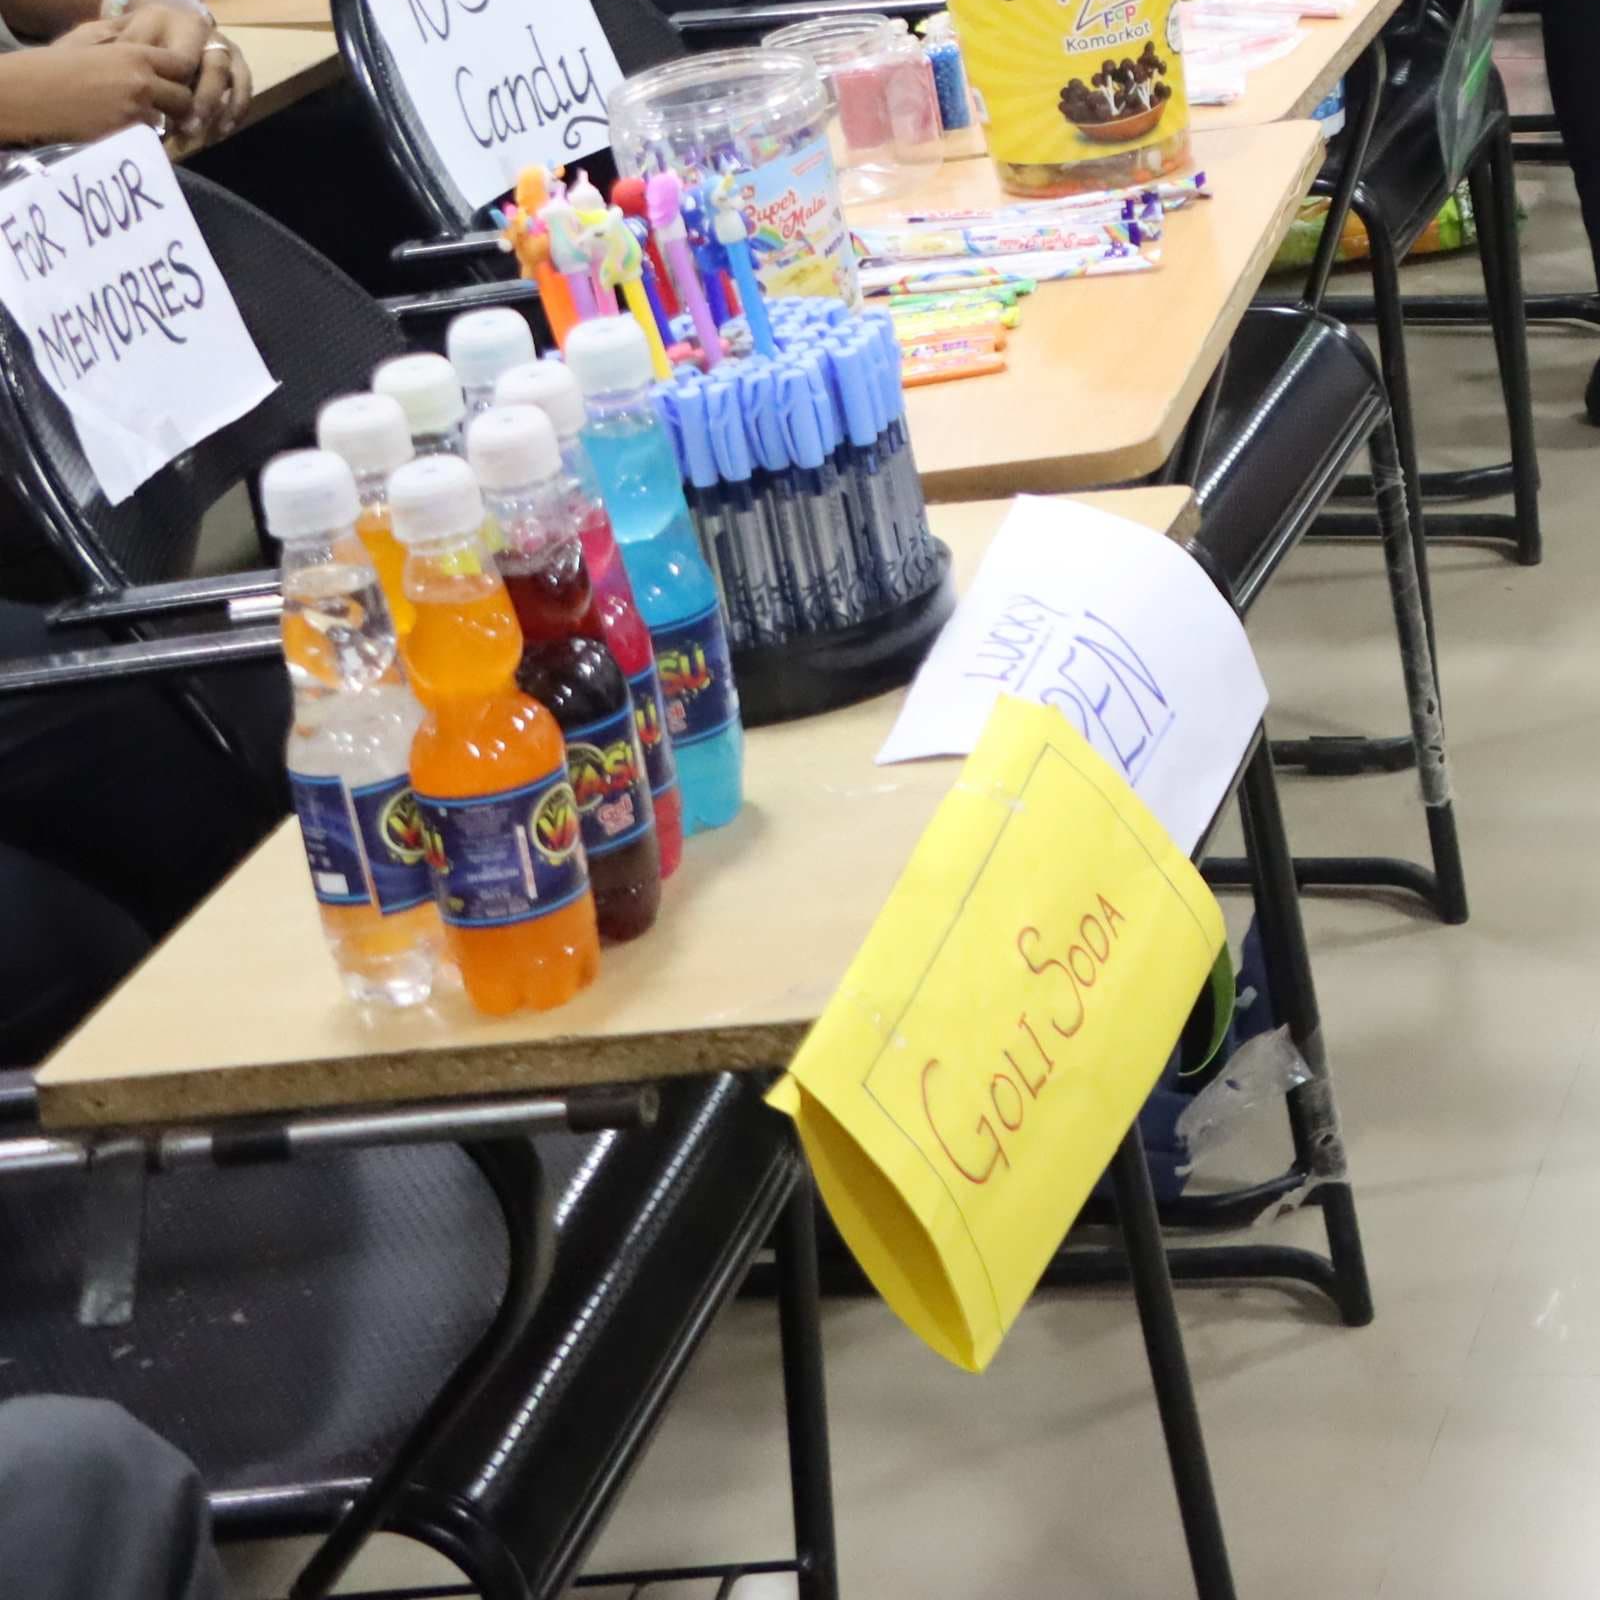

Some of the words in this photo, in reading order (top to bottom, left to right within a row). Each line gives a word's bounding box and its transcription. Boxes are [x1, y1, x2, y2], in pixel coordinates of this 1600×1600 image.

[455, 24, 610, 150] Candy
[57, 158, 165, 248] YOUR
[37, 240, 205, 390] MEMORIES
[963, 594, 1070, 682] LUCKY
[921, 1010, 1056, 1185] GOLI
[1016, 894, 1127, 1039] SODA
